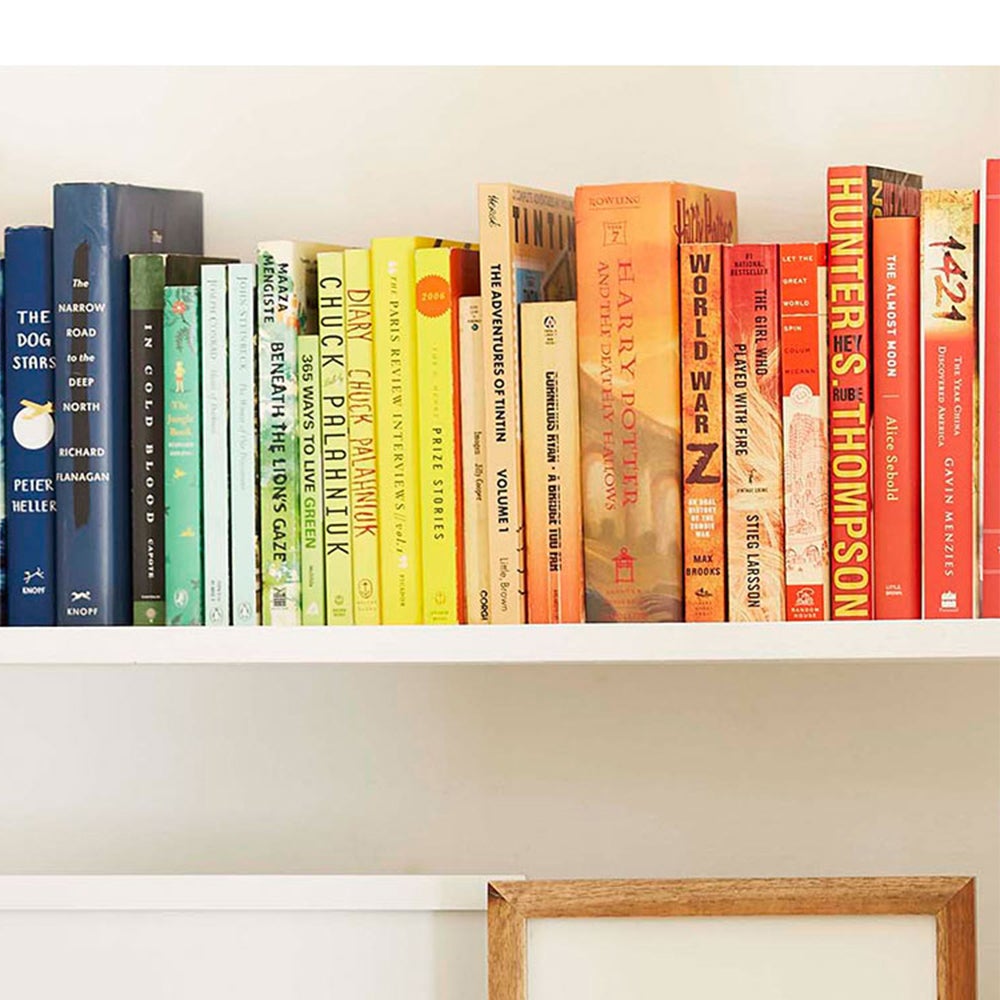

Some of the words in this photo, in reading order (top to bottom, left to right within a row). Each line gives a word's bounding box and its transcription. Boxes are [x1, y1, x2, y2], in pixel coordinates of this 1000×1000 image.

[828, 175, 866, 329] HUNTER
[886, 255, 898, 279] THE
[73, 279, 90, 288] The
[263, 255, 275, 324] MENGISTE
[277, 262, 289, 313] MAAZA
[490, 263, 502, 288] THE
[596, 260, 610, 298] AND
[929, 234, 969, 322] 1421
[58, 303, 106, 312] NARROW
[347, 289, 373, 342] DIARY
[421, 292, 446, 302] 2006
[688, 253, 712, 361] WORLD
[755, 289, 767, 311] THE
[887, 283, 898, 336] ALMOST
[16, 310, 51, 324] THE
[66, 328, 97, 337] ROAD
[320, 276, 344, 368] CHUCK
[389, 301, 400, 342] PARIS
[491, 290, 505, 376] ADVENTURES
[598, 302, 611, 336] THE
[617, 258, 637, 377] HARRY
[756, 315, 767, 343] GIRL
[17, 333, 52, 348] DOG
[143, 325, 153, 348] IN
[832, 334, 863, 352] HEY
[11, 356, 57, 370] STARS
[80, 354, 96, 363] the
[302, 354, 314, 382] 365
[391, 349, 401, 405] REVIEW
[734, 344, 747, 389] PLAYED
[757, 348, 768, 376] WHO
[831, 352, 867, 388] S.
[887, 340, 898, 377] MOON
[938, 345, 947, 403] DISCOVERED
[953, 356, 963, 377] THE
[68, 377, 95, 387] DEEP
[144, 365, 154, 427] COLD
[270, 342, 286, 418] BENEATH
[348, 369, 373, 425] CHUCK
[493, 378, 505, 396] OF
[600, 342, 614, 422] DEATHLY
[833, 386, 864, 402] RUBE
[954, 379, 963, 403] YEAR
[62, 402, 102, 412] NORTH
[302, 385, 315, 430] WAYS
[545, 371, 560, 431] CORNELIUS
[690, 371, 713, 434] WAR
[735, 393, 748, 423] WITH
[268, 422, 287, 453] THE
[494, 398, 507, 443] TINTIN
[885, 416, 899, 450] Alice
[938, 405, 947, 448] AMERICA
[954, 405, 963, 437] CHINA
[59, 448, 106, 457] RICHARD
[303, 434, 316, 456] TO
[432, 427, 444, 471] PRIZE
[547, 433, 560, 463] RYAN
[621, 393, 639, 507] POTTER
[735, 428, 748, 456] FIRE
[55, 472, 110, 482] FLANAGAN
[304, 460, 316, 492] LIVE
[323, 396, 349, 556] PALAHNIUK
[393, 413, 406, 510] INTERVIEWS
[548, 474, 561, 483] A
[602, 431, 616, 511] HALLOWS
[685, 442, 721, 485] Z
[886, 456, 899, 501] Sebold
[14, 479, 54, 492] PETER
[145, 444, 155, 524] BLOOD
[272, 458, 287, 513] LION'S
[350, 438, 378, 538] PALAHNIUK
[496, 469, 508, 524] VOLUME
[944, 457, 954, 504] GAVIN
[12, 500, 56, 513] HELLER
[432, 479, 445, 542] STORIES
[548, 484, 561, 525] BRIDGE
[832, 402, 870, 618] THOMPSON
[272, 518, 287, 562] GAZE
[304, 498, 317, 549] GREEN
[549, 527, 562, 549] TOO
[746, 515, 759, 549] STIEG
[147, 538, 155, 579] CAPOTE
[550, 551, 563, 572] FAR
[693, 555, 714, 563] MAX
[944, 512, 954, 578] MENZIES
[686, 567, 721, 577] BROOKS
[747, 553, 761, 608] LARSSON
[66, 608, 98, 616] KNOPF
[480, 590, 489, 621] CORGI
